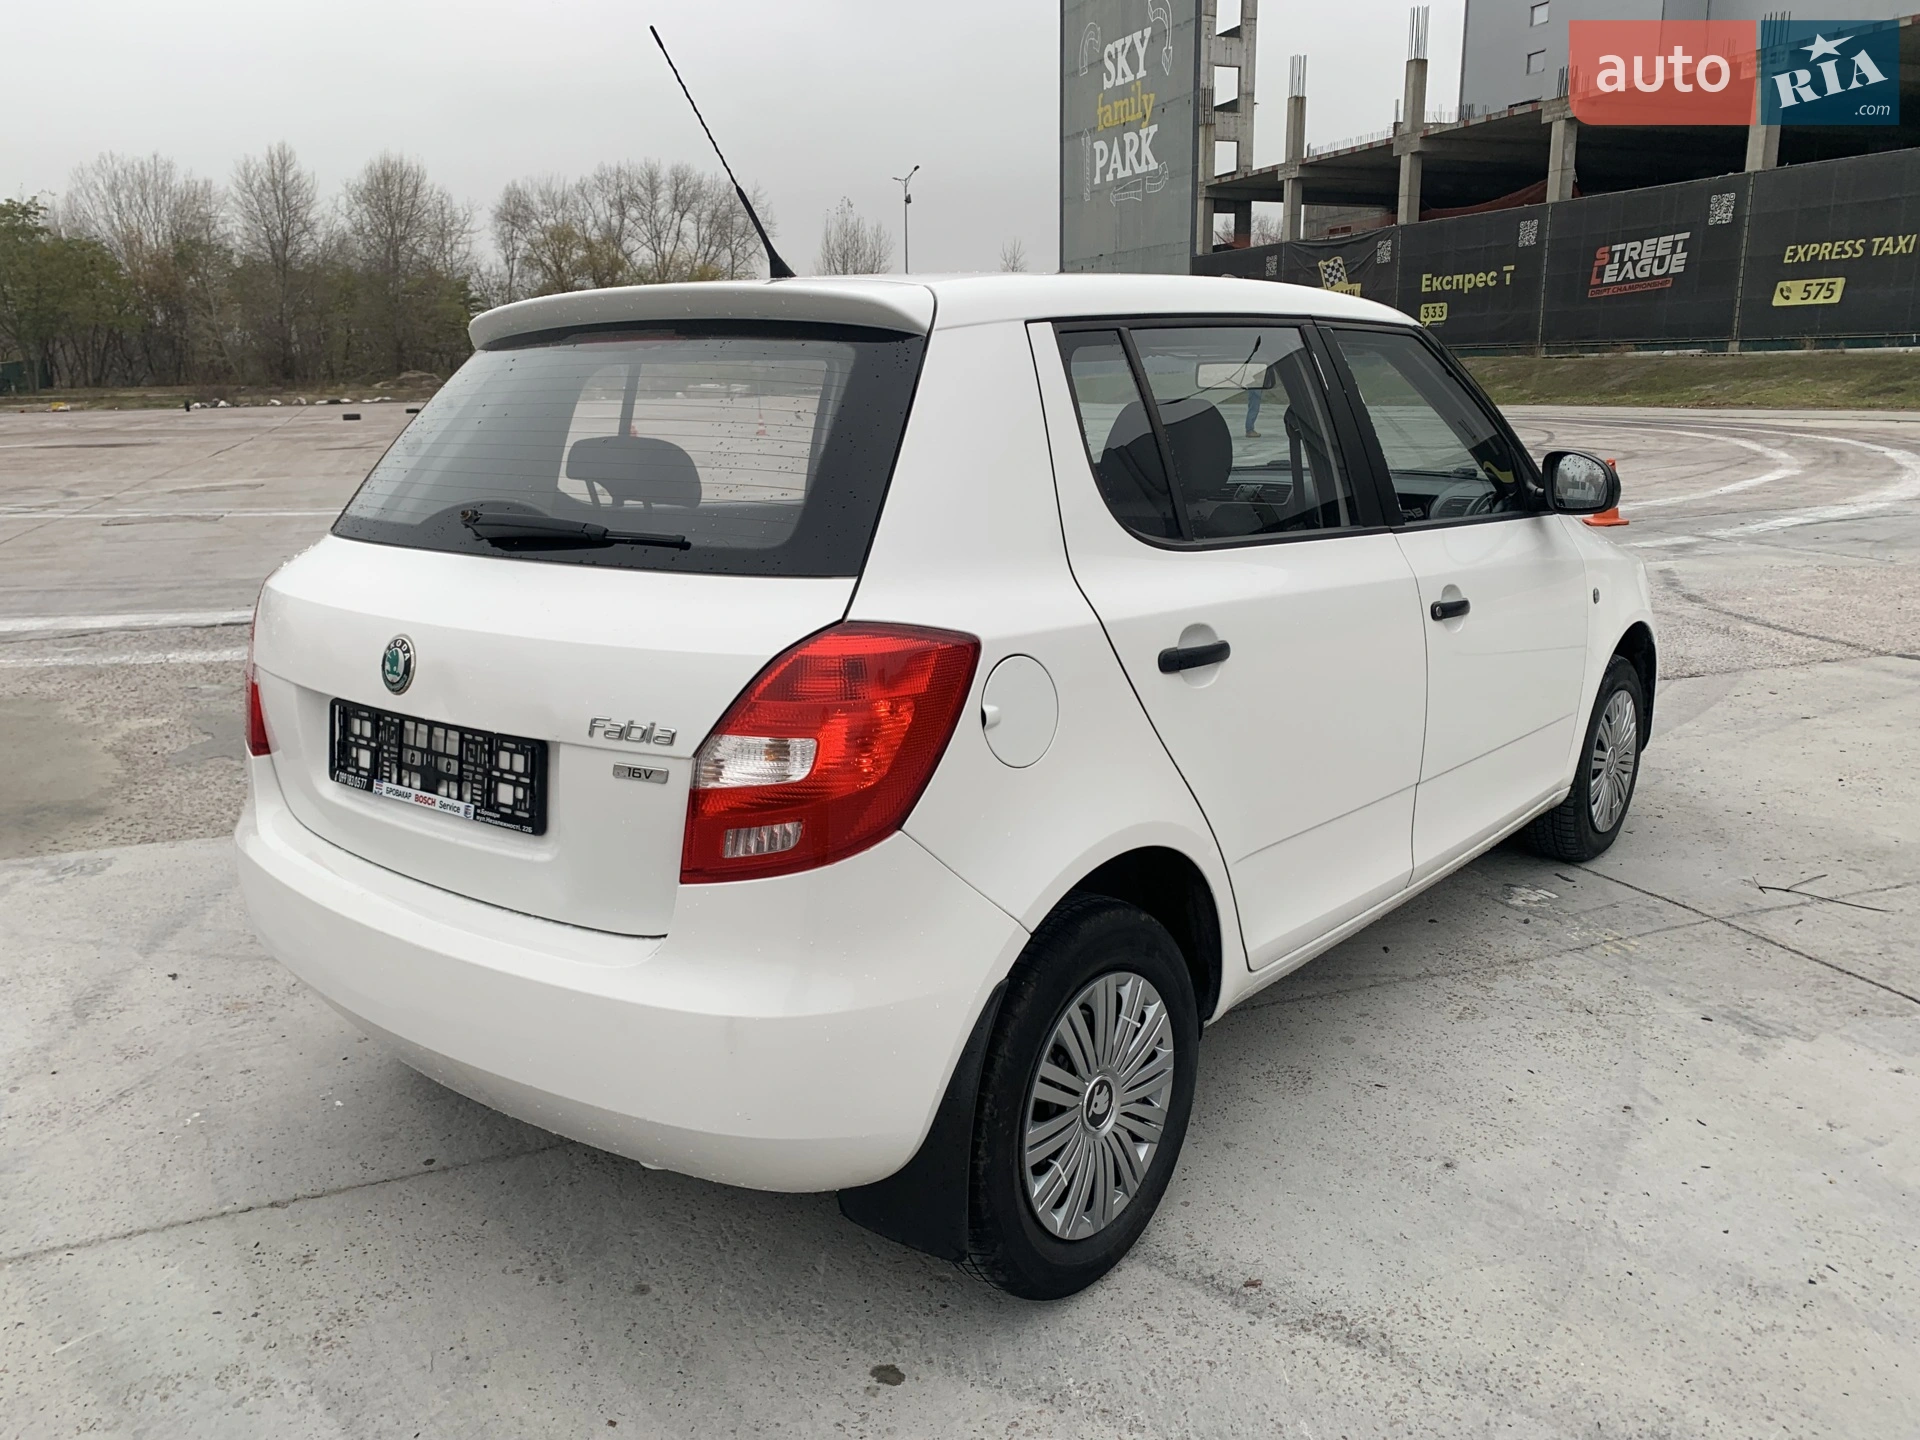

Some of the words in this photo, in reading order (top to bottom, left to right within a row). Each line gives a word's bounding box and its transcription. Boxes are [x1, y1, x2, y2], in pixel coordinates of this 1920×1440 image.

[1103, 27, 1151, 90] SKY
[1097, 80, 1155, 131] family
[1093, 124, 1158, 185] PARK
[1594, 232, 1691, 266] STREET
[1783, 239, 1866, 264] EXPRESS
[1871, 234, 1918, 257] TAXI
[1421, 271, 1498, 294] Експрес
[1590, 252, 1688, 285] LEAGUE
[1590, 287, 1611, 296] DRIFT
[1611, 280, 1671, 294] CHAMPIONSHIP
[1800, 282, 1837, 301] 575
[1423, 306, 1445, 319] 333
[588, 716, 678, 746] Fabia
[385, 787, 412, 799] БРОВАКАР
[414, 794, 436, 807] BOSCH
[439, 801, 461, 814] Service
